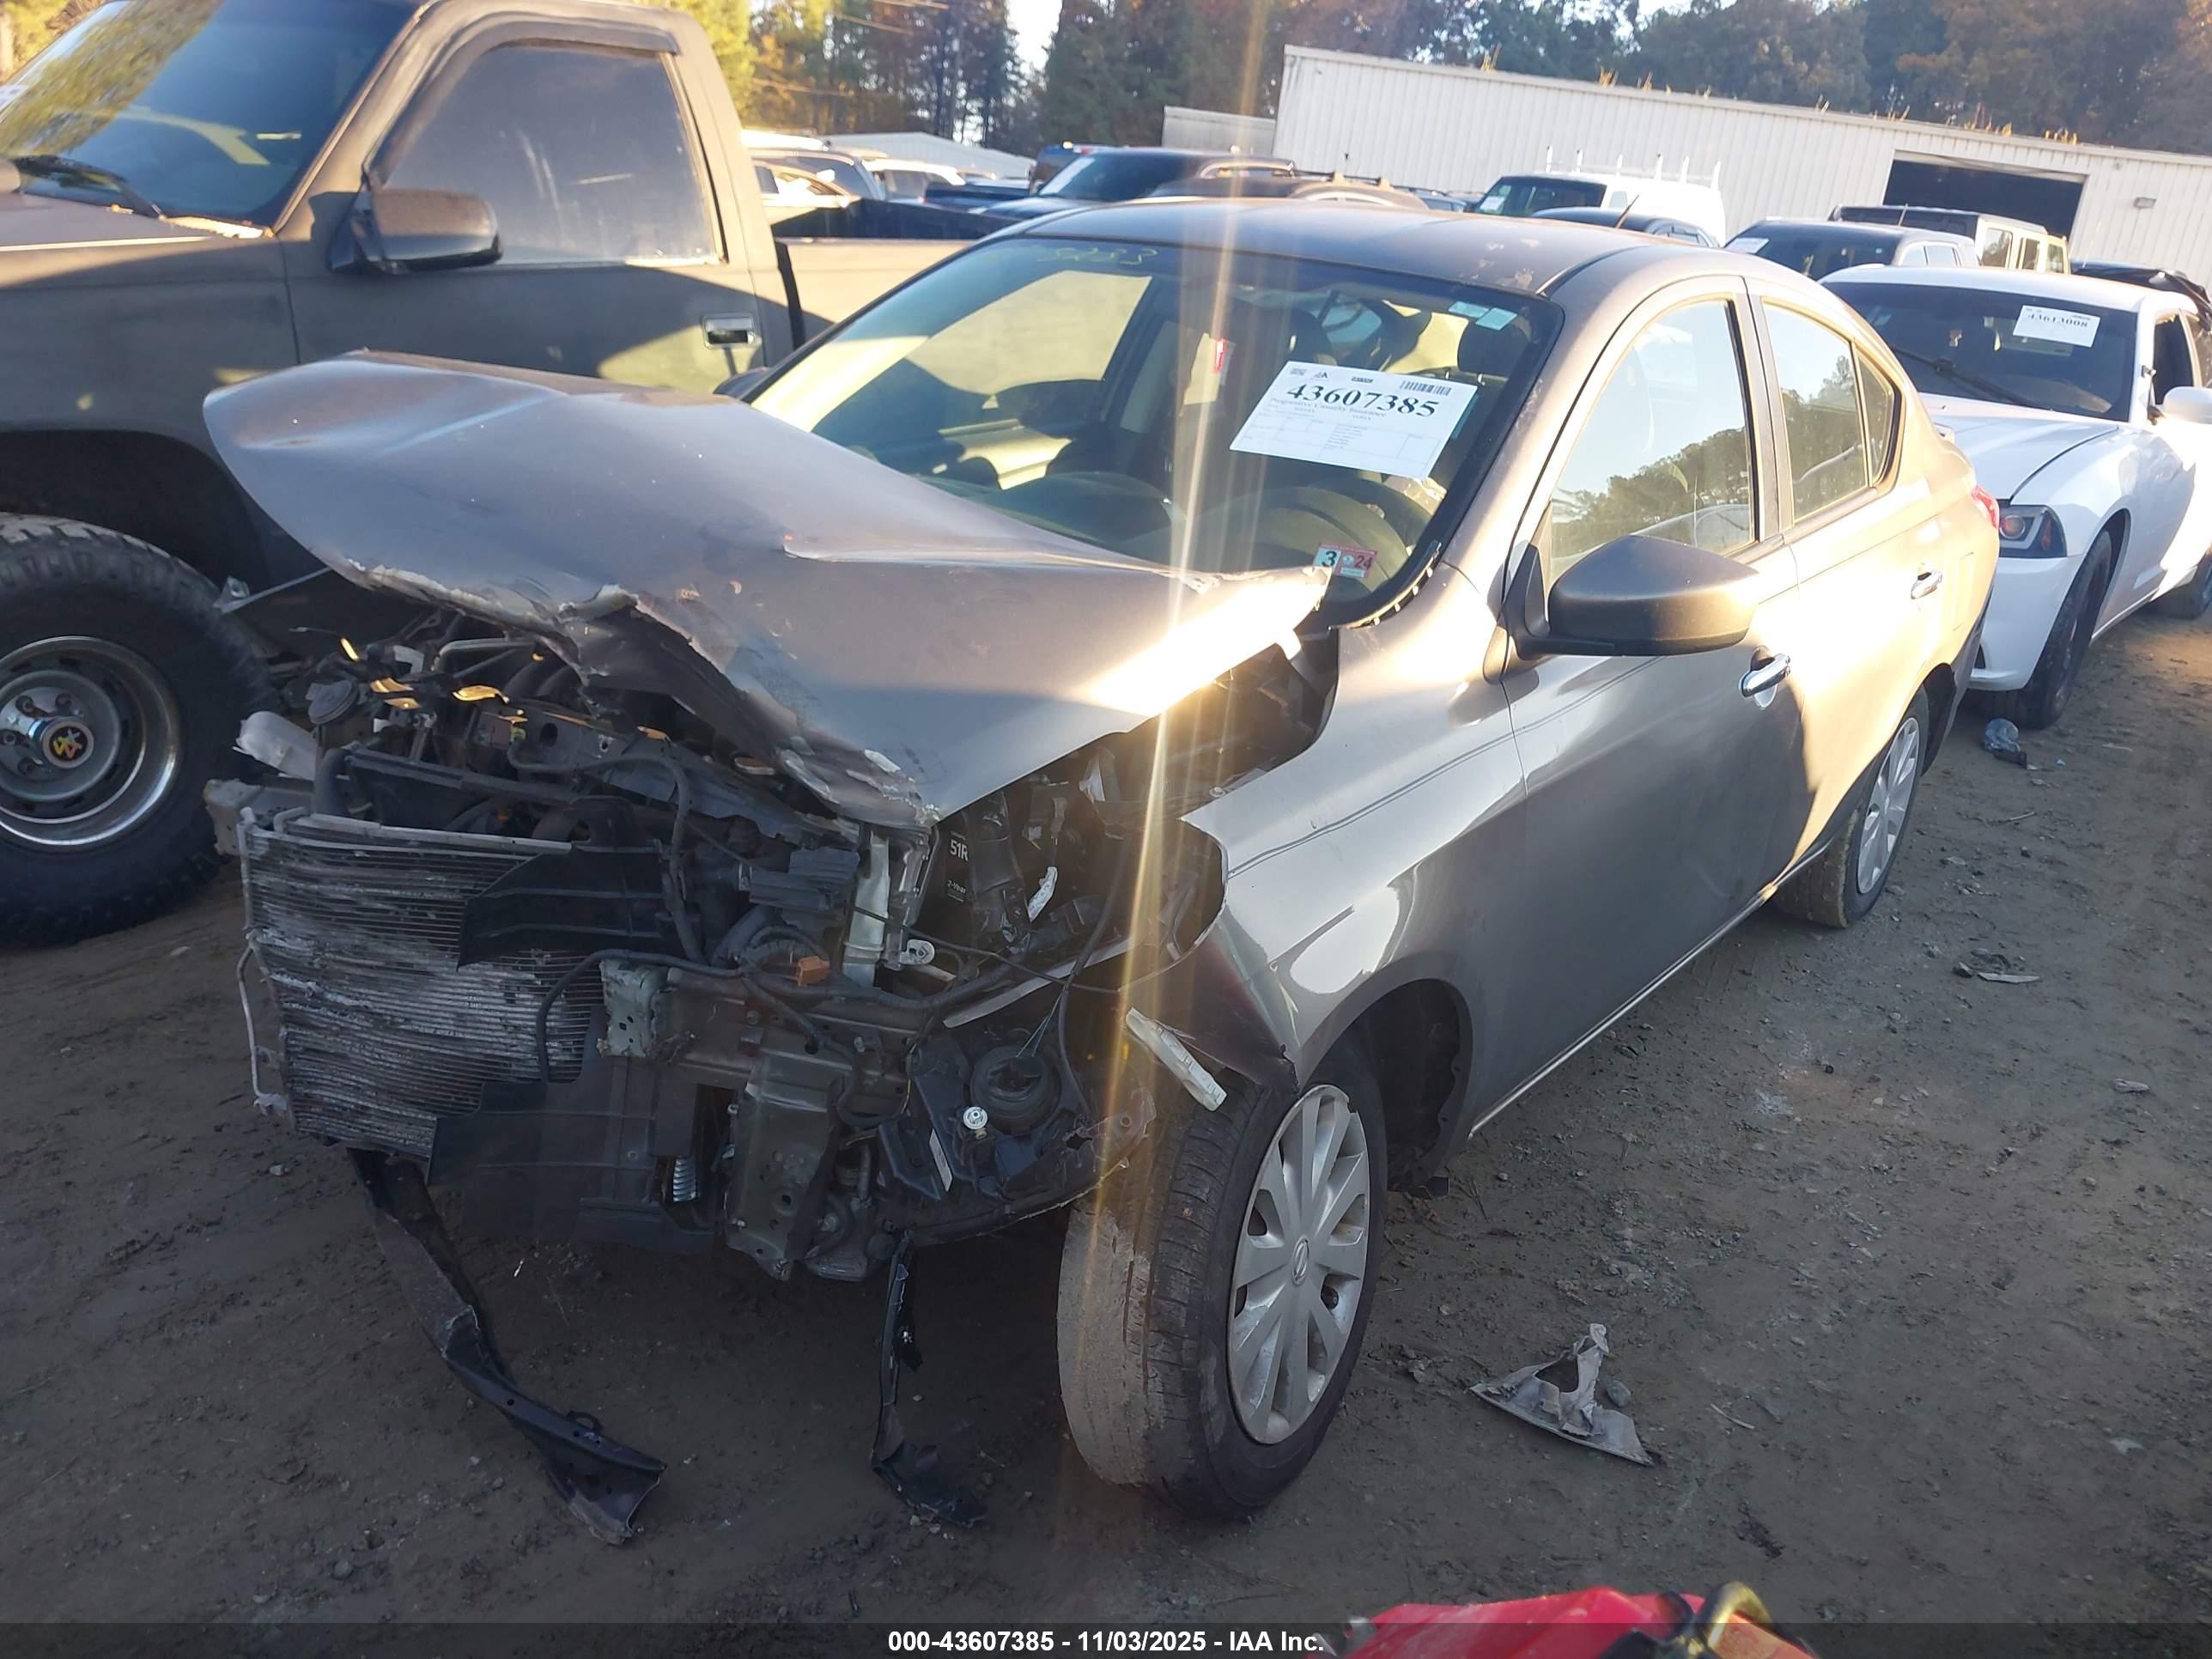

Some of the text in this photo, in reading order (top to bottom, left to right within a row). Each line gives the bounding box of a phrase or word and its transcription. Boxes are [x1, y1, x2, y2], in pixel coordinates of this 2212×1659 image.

[1287, 383, 1440, 418] 43607385
[1322, 550, 1373, 570] 3 24
[950, 838, 969, 862] 51R
